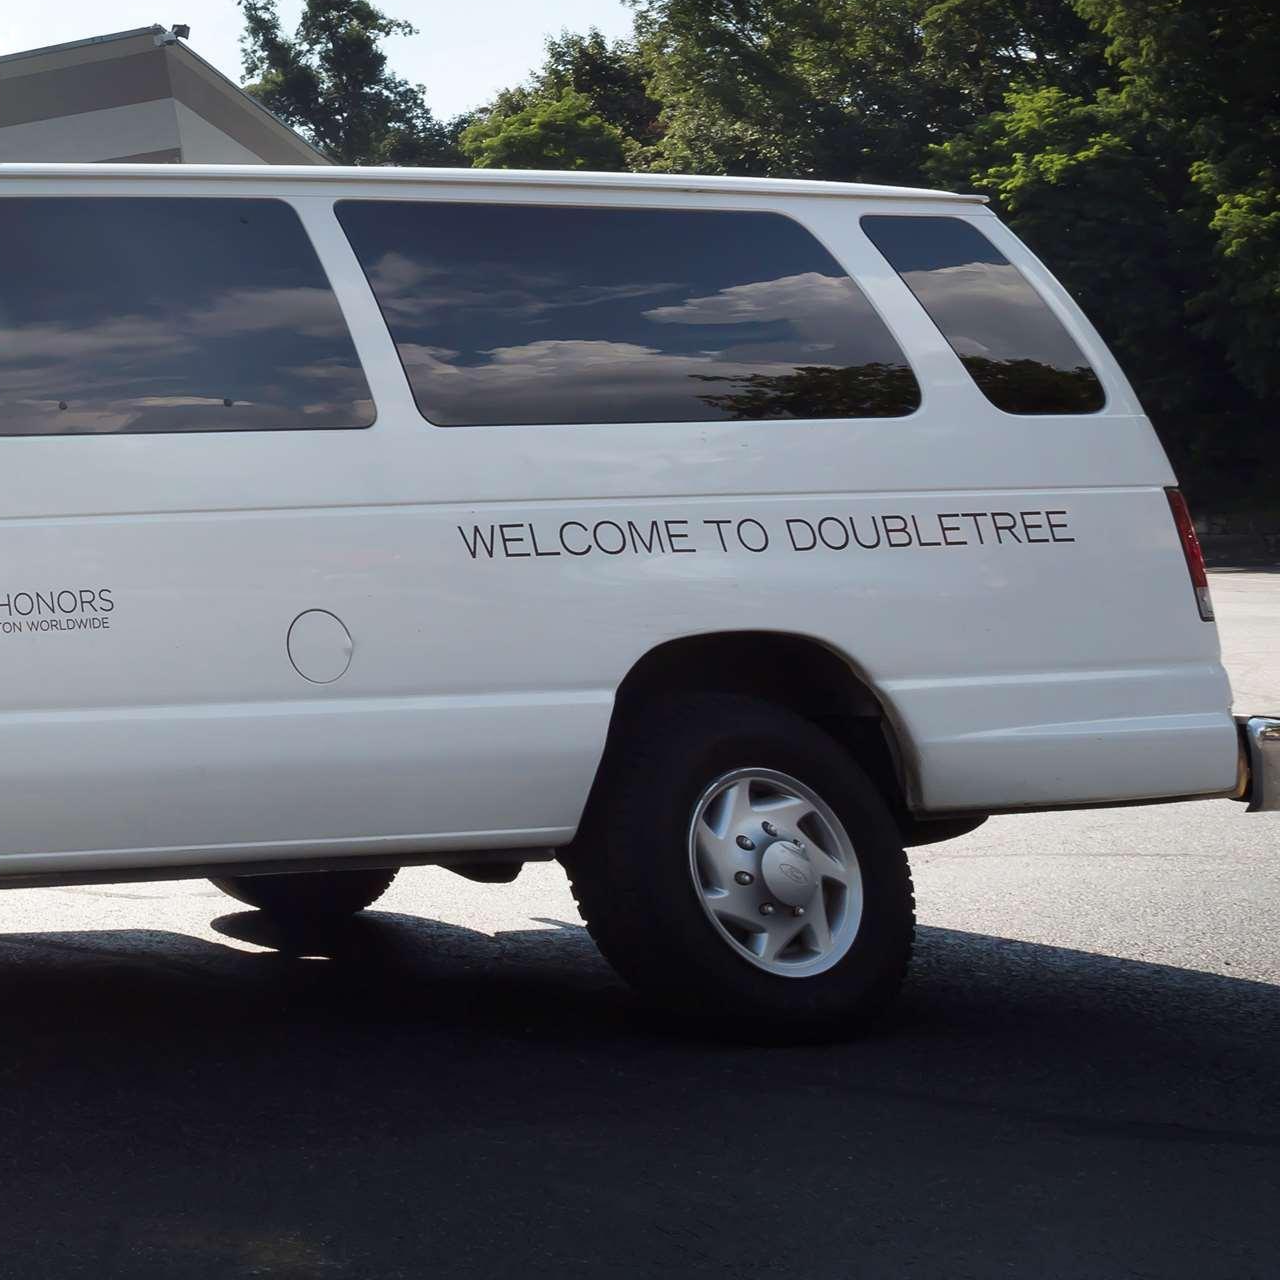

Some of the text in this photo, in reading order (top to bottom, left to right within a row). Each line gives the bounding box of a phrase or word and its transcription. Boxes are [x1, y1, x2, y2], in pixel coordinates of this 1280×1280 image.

[457, 510, 1075, 559] WELCOME TO DOUBLETREE
[26, 617, 110, 632] WORLDWIDE
